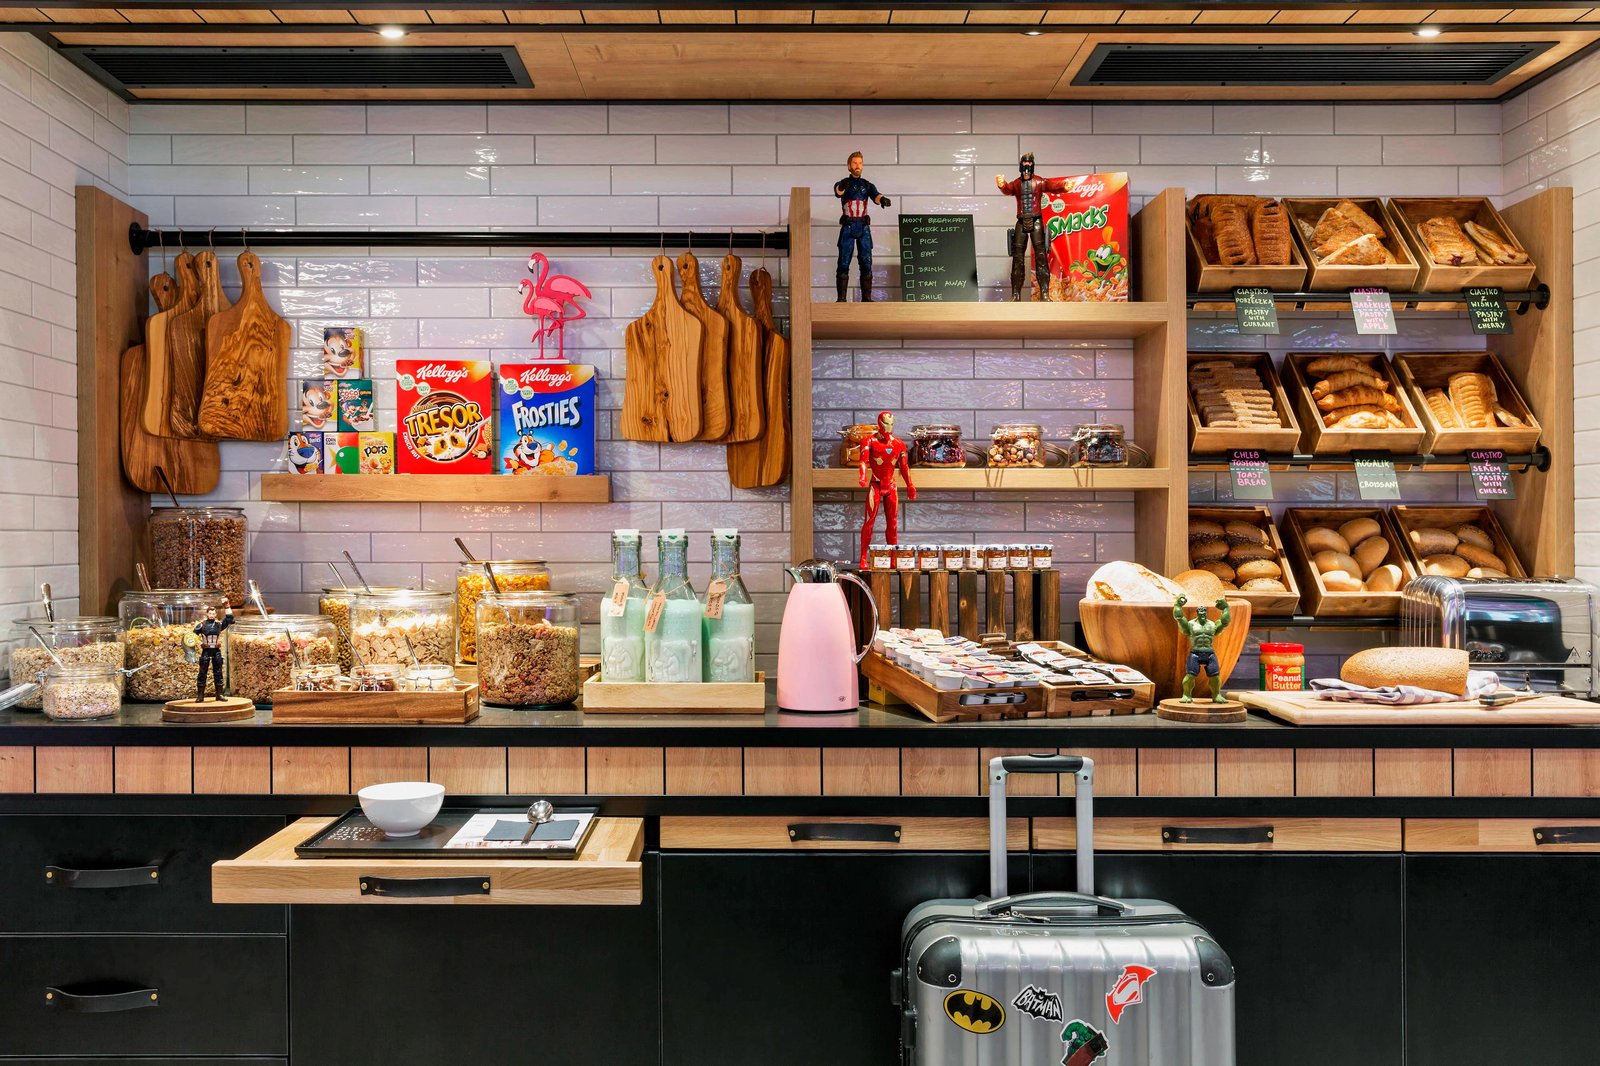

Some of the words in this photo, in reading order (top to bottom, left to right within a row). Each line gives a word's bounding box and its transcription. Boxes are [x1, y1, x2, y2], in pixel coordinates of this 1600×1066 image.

[920, 250, 938, 258] EAT
[918, 265, 946, 273] DRINK
[944, 280, 967, 288] AWAY
[1353, 287, 1384, 295] CIASTKO
[1469, 288, 1499, 296] CIASTKO
[920, 293, 943, 301] SMILE
[1359, 310, 1388, 318] PASTRY
[1475, 310, 1504, 318] PASTRY
[1362, 322, 1390, 330] APPLE
[1477, 322, 1506, 330] CHERRY
[416, 363, 469, 383] Kellogg's
[520, 367, 573, 387] Kellogg's
[404, 403, 483, 437] TRESOR
[1233, 451, 1260, 459] CHLEB
[1471, 451, 1503, 459] CIASTKO
[1355, 459, 1390, 468] ROGALIK
[1237, 471, 1264, 479] TOAST
[1237, 478, 1267, 486] BREAD
[1272, 674, 1302, 683] Peanut
[1272, 682, 1302, 690] Butter
[1015, 989, 1062, 1020] BATMAN
